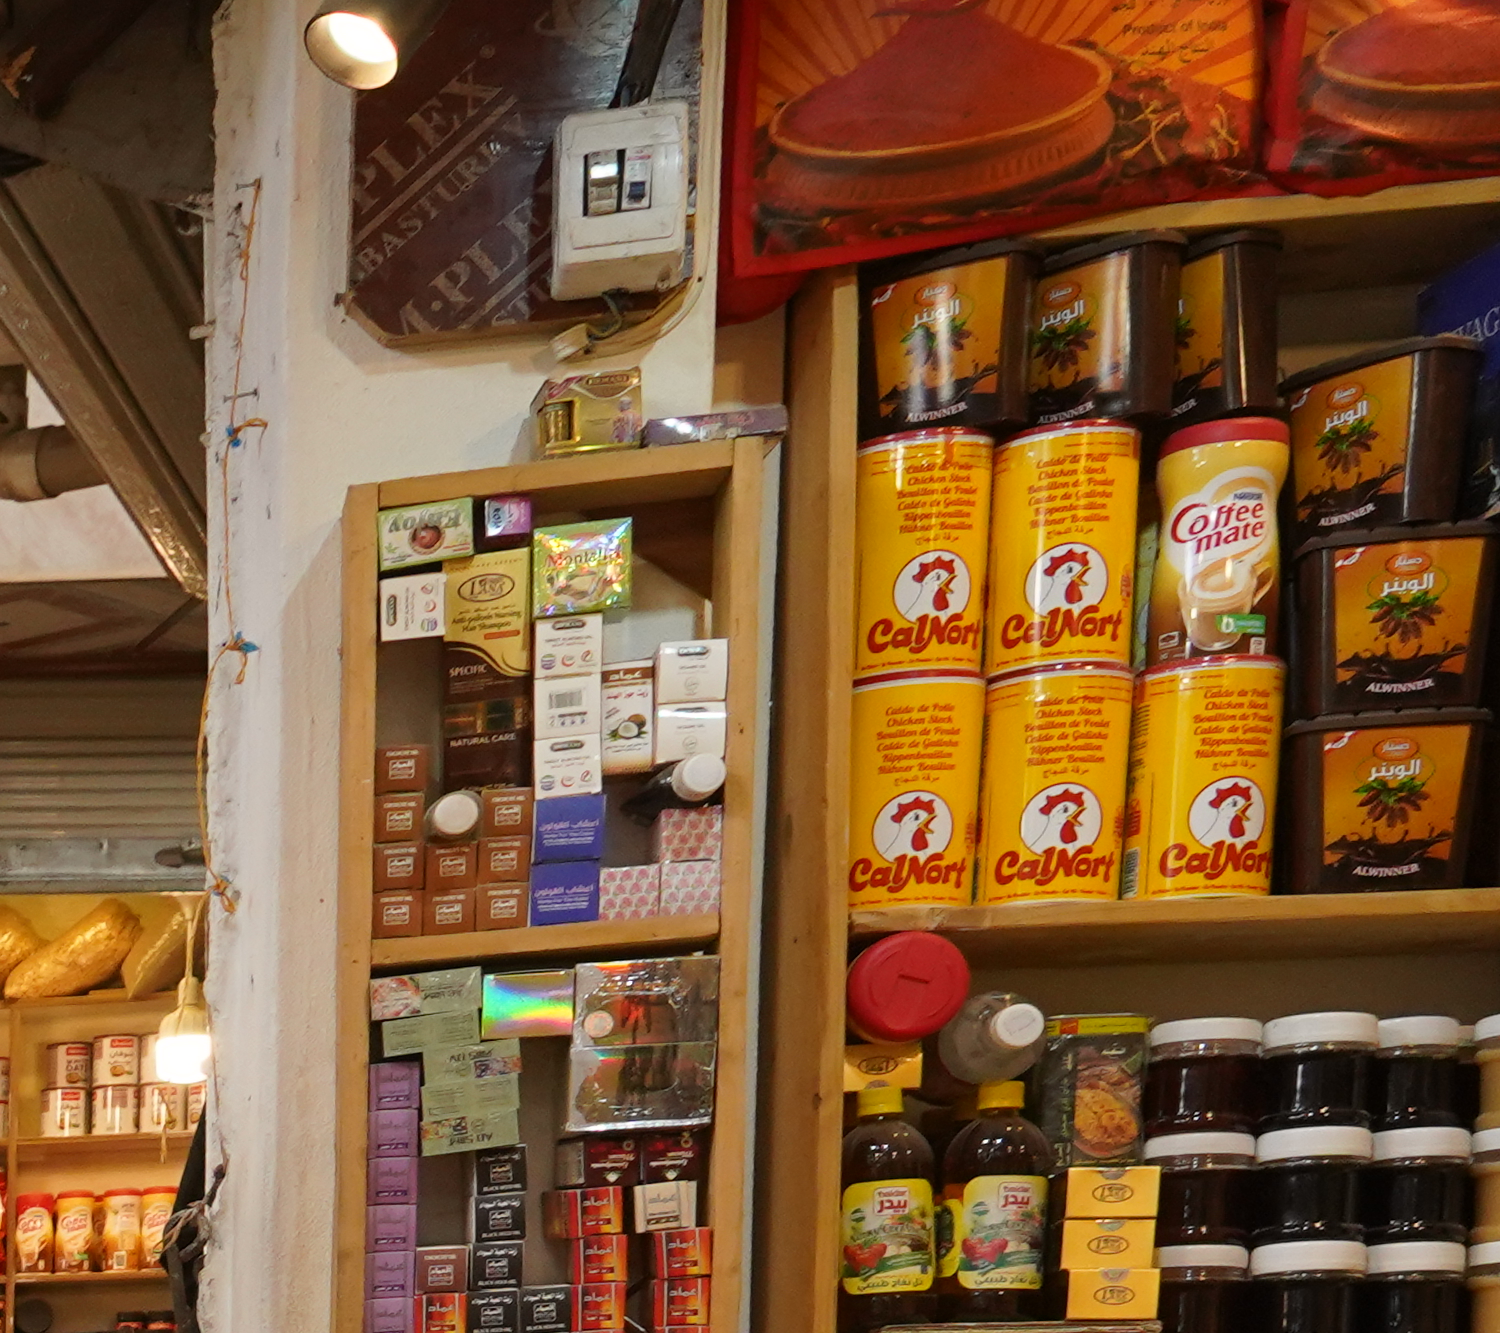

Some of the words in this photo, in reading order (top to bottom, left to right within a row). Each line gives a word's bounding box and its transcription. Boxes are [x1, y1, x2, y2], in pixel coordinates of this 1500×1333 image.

[1171, 502, 1265, 544] Coffee
[1195, 521, 1266, 554] mate
[867, 612, 981, 654] CalNort
[1001, 604, 1122, 649] CalNort
[887, 716, 925, 727] Chicken
[849, 853, 967, 893] CalNort
[994, 845, 1114, 886] CalNort
[877, 1199, 908, 1214] بيدر
[1001, 1193, 1031, 1208] بيدر
